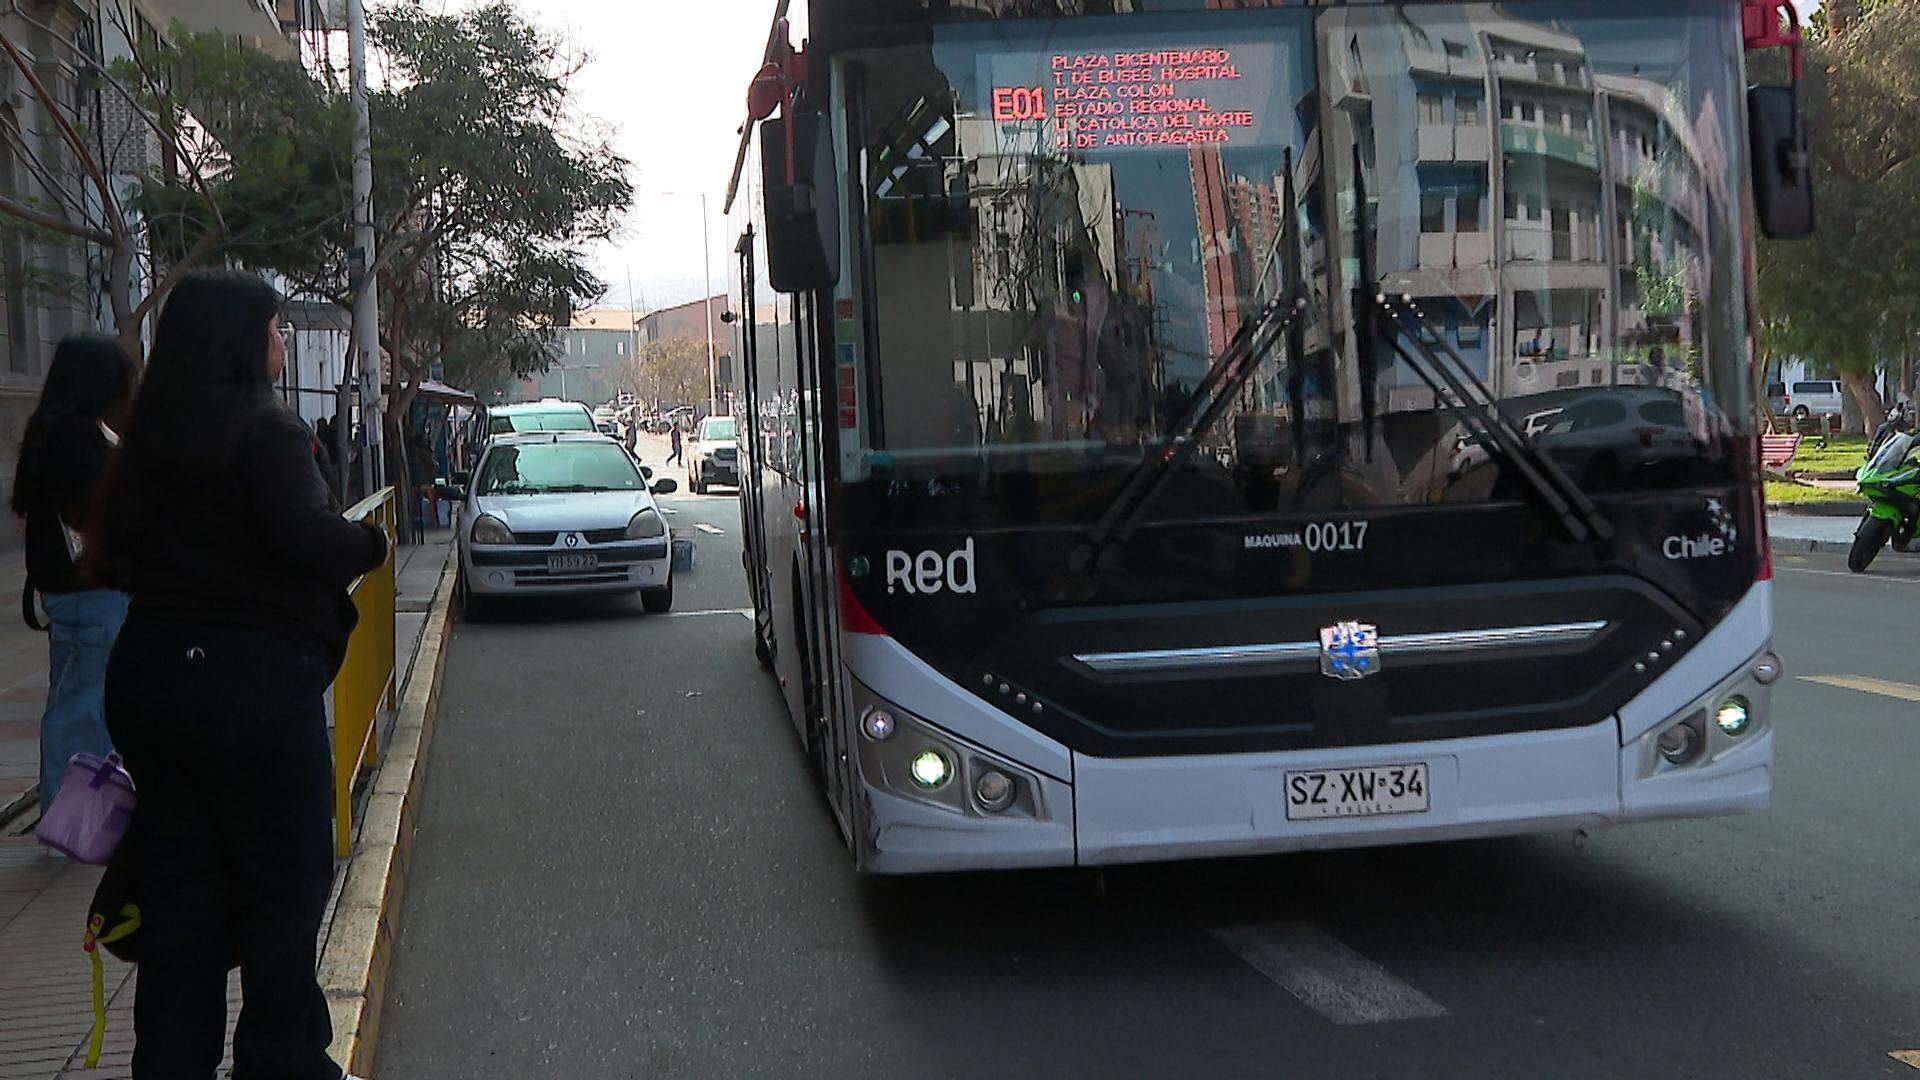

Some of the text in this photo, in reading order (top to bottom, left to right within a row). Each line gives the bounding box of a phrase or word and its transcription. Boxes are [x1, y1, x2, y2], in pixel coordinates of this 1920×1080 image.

[1052, 49, 1230, 69] PLAZA BICENTENARIO
[1071, 71, 1093, 83] DE
[1160, 65, 1241, 80] HOSPITAL
[993, 86, 1047, 120] E01
[1054, 86, 1111, 100] PLAZA
[1055, 98, 1212, 117] ESTADIO REGIONAL
[1076, 115, 1158, 131] CATOLICA
[1162, 113, 1193, 128] DEL
[1198, 111, 1253, 127] NORTE
[1076, 133, 1099, 148] DE
[1103, 129, 1230, 146] ANTOFAGASTA
[1244, 521, 1369, 552] MAQUINA 0017
[1662, 533, 1726, 560] Chile
[886, 535, 977, 595] Red
